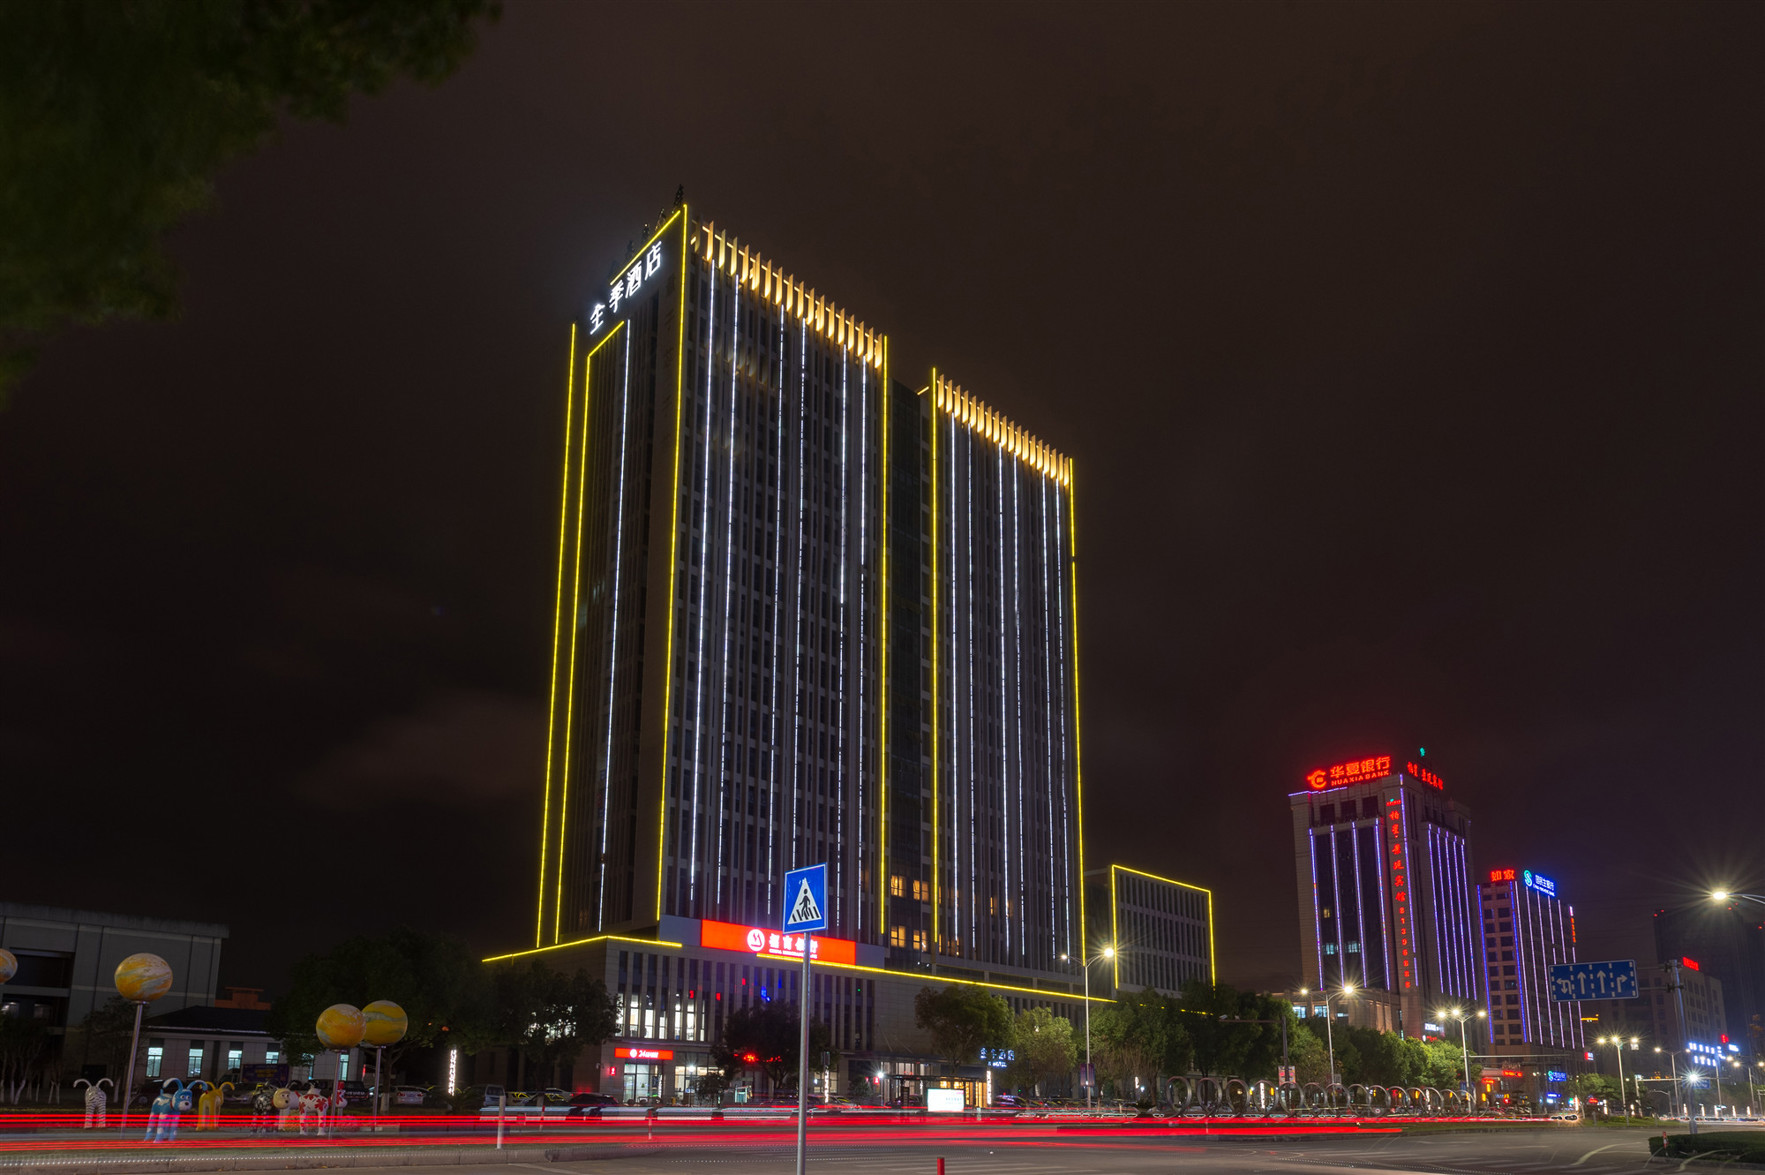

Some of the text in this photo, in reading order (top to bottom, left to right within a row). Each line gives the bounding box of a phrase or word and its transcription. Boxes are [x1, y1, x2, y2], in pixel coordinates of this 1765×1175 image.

[589, 240, 662, 335] 全季酒店
[1330, 756, 1390, 778] 华夏银行
[1365, 770, 1390, 780] BANK
